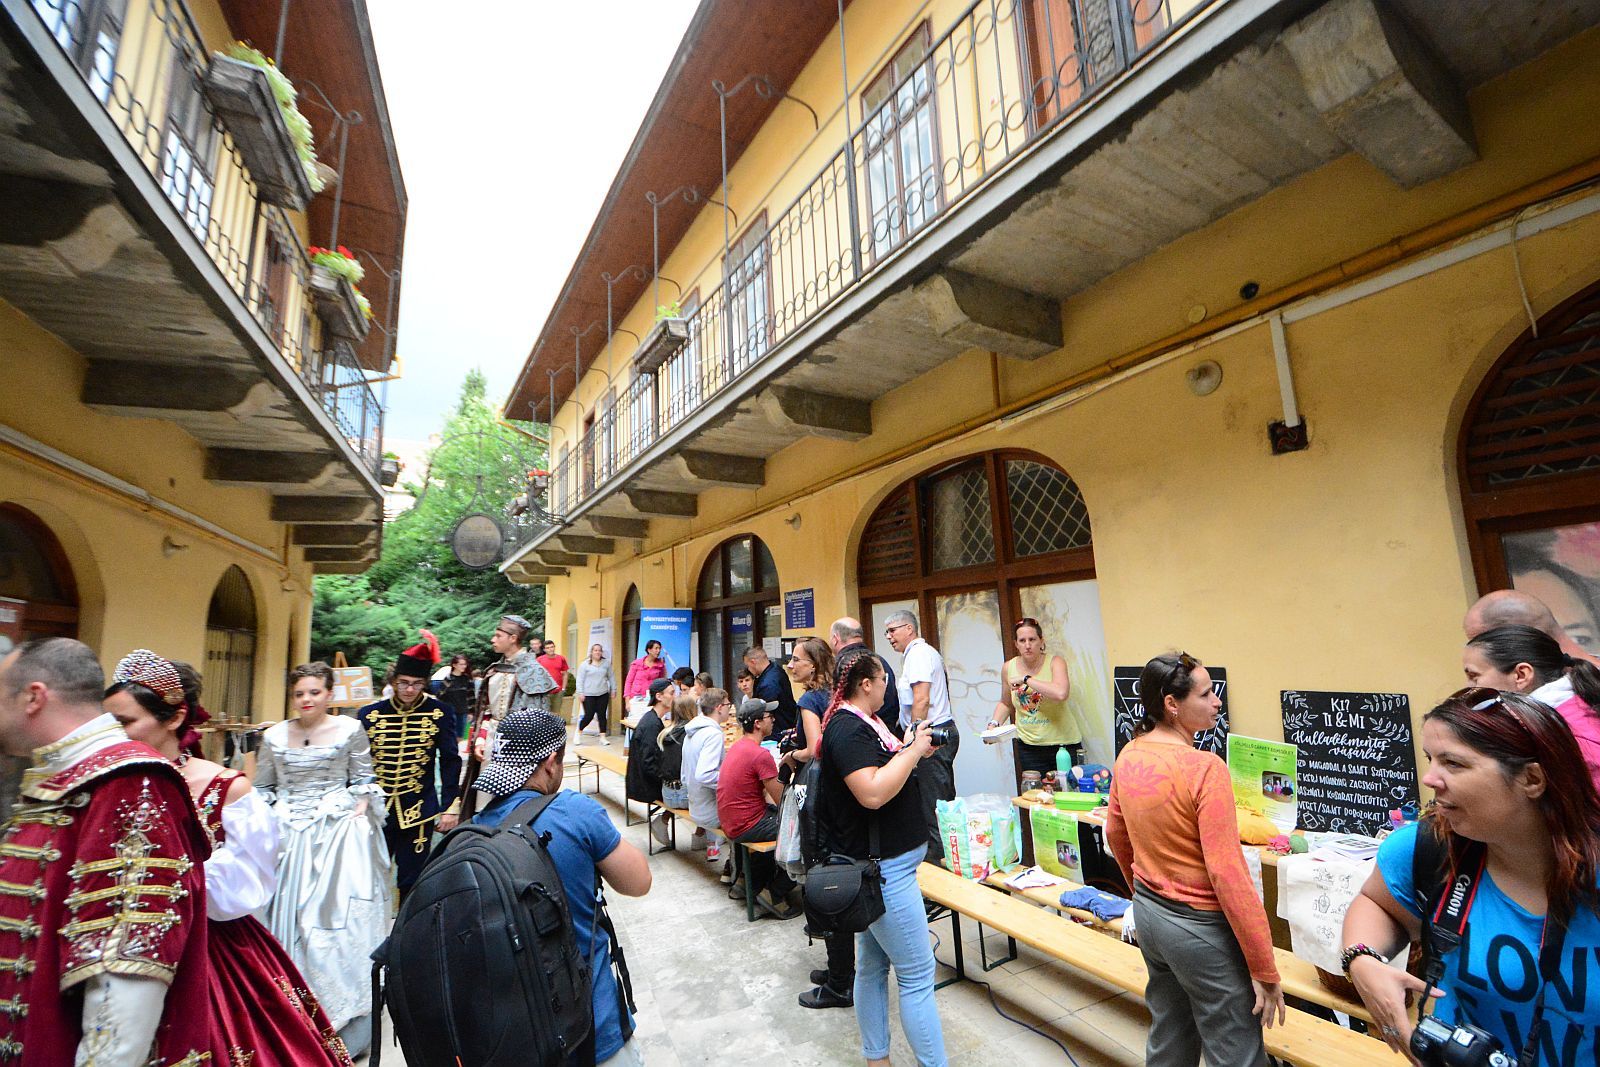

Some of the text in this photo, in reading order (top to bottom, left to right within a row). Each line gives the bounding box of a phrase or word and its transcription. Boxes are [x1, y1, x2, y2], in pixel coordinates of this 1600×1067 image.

[1331, 698, 1350, 712] KI?
[1322, 711, 1365, 729] TI & MI
[1291, 730, 1391, 751] Hulladékmentes
[1328, 747, 1388, 762] vásárlás
[1309, 760, 1341, 772] MAGADDAL
[1342, 764, 1347, 772] A
[1446, 874, 1471, 917] Canon
